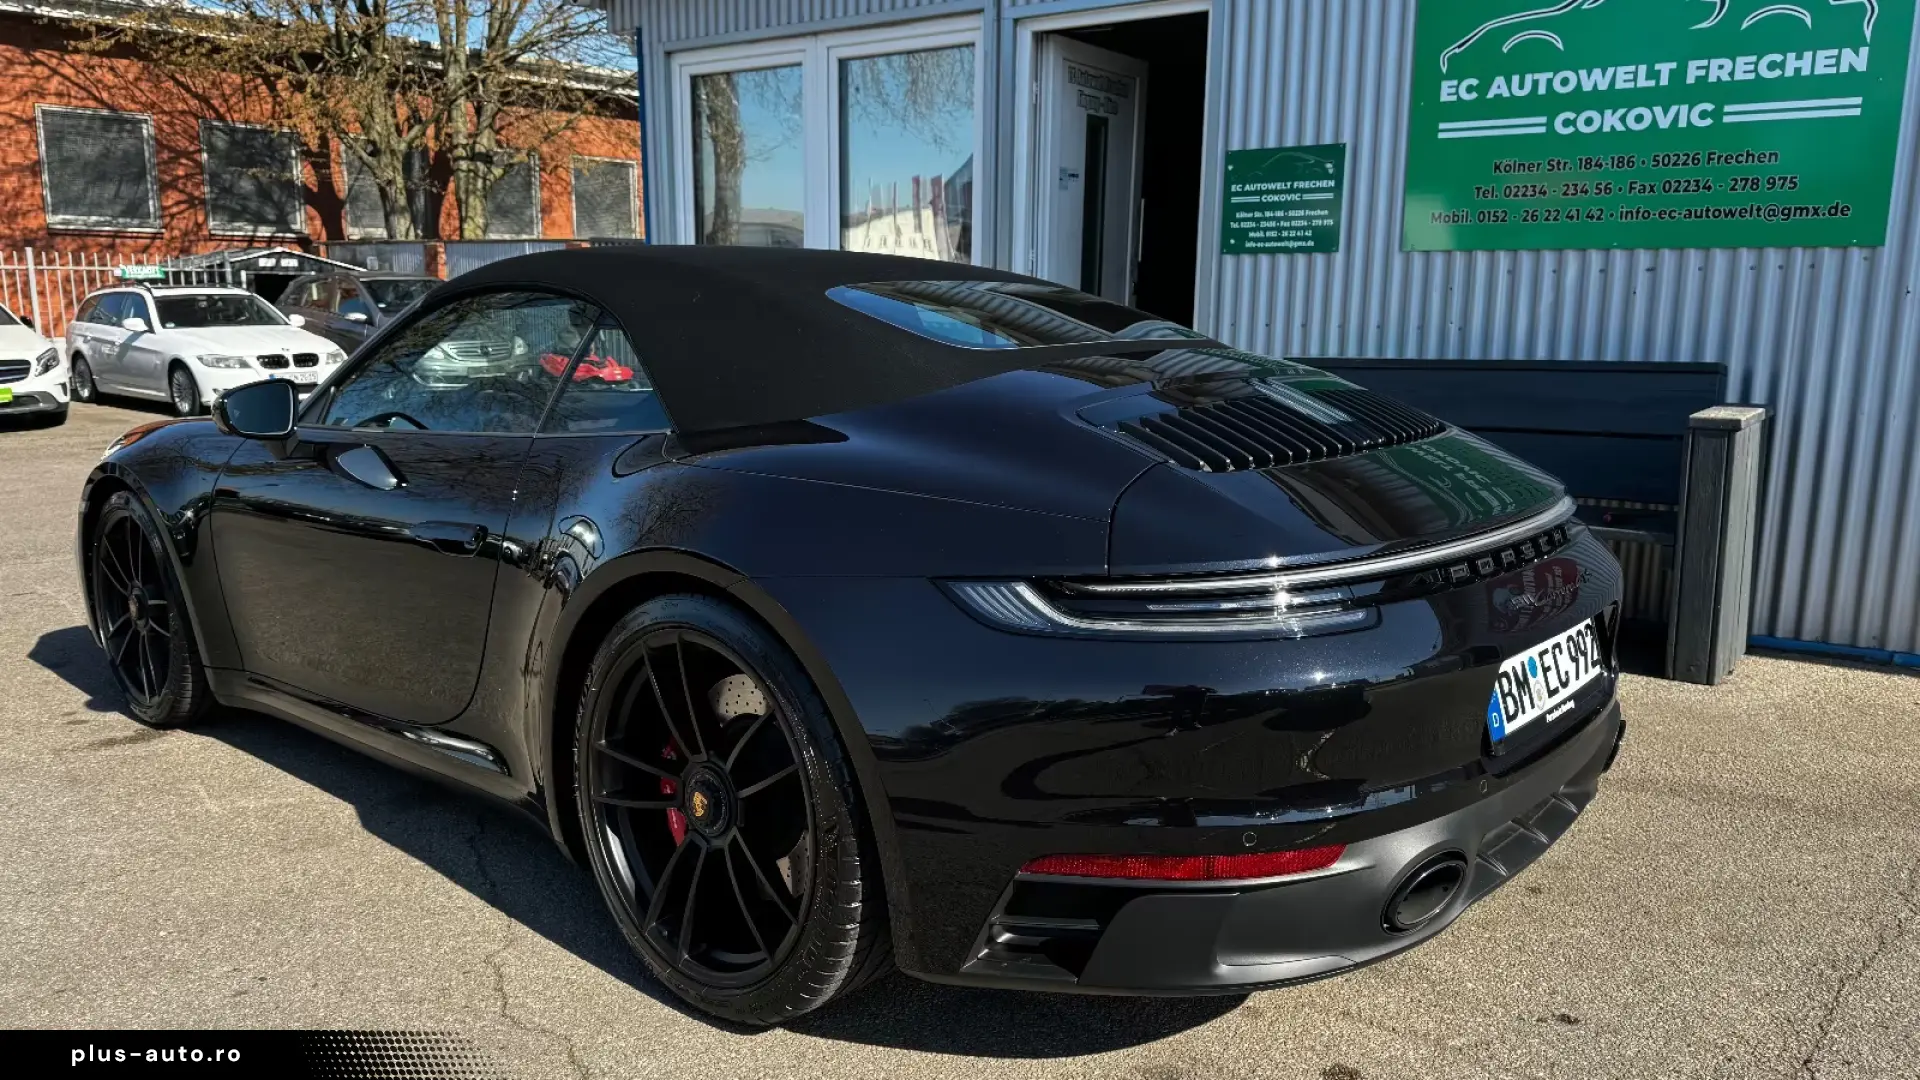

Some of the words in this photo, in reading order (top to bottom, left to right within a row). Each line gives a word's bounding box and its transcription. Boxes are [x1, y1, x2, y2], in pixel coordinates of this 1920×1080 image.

[1440, 78, 1479, 102] EC
[1486, 61, 1678, 99] AUTOWELT
[1685, 46, 1870, 84] FRECHEN
[1553, 103, 1717, 136] COKOVIC
[1493, 157, 1543, 175] Kölner
[1546, 156, 1573, 173] Str.
[1576, 154, 1636, 172] 184-186
[1650, 152, 1701, 169] 50226
[1706, 148, 1779, 167] Frechen
[1231, 184, 1243, 192] EC
[1244, 182, 1292, 191] AUTOWELT
[1293, 180, 1335, 189] FRECHEN
[1261, 193, 1302, 202] COKOVIC
[1473, 185, 1499, 201] Tel.
[1503, 183, 1548, 199] 02234
[1561, 182, 1590, 198] 234
[1593, 181, 1613, 197] 56
[1627, 180, 1656, 196] Fax
[1661, 177, 1713, 195] 02234
[1728, 176, 1760, 193] 278
[1764, 174, 1799, 192] 975
[1430, 208, 1472, 225] Mobil.
[1476, 208, 1508, 224] 0152
[1520, 208, 1539, 223] 26
[1542, 208, 1562, 223] 22
[1564, 207, 1582, 223] 41
[1584, 207, 1605, 223] 42
[1618, 201, 1851, 224] info-ec-autowelt@gmx.de
[1491, 711, 1501, 728] D
[1498, 659, 1536, 725] BM
[1538, 639, 1570, 699] EC
